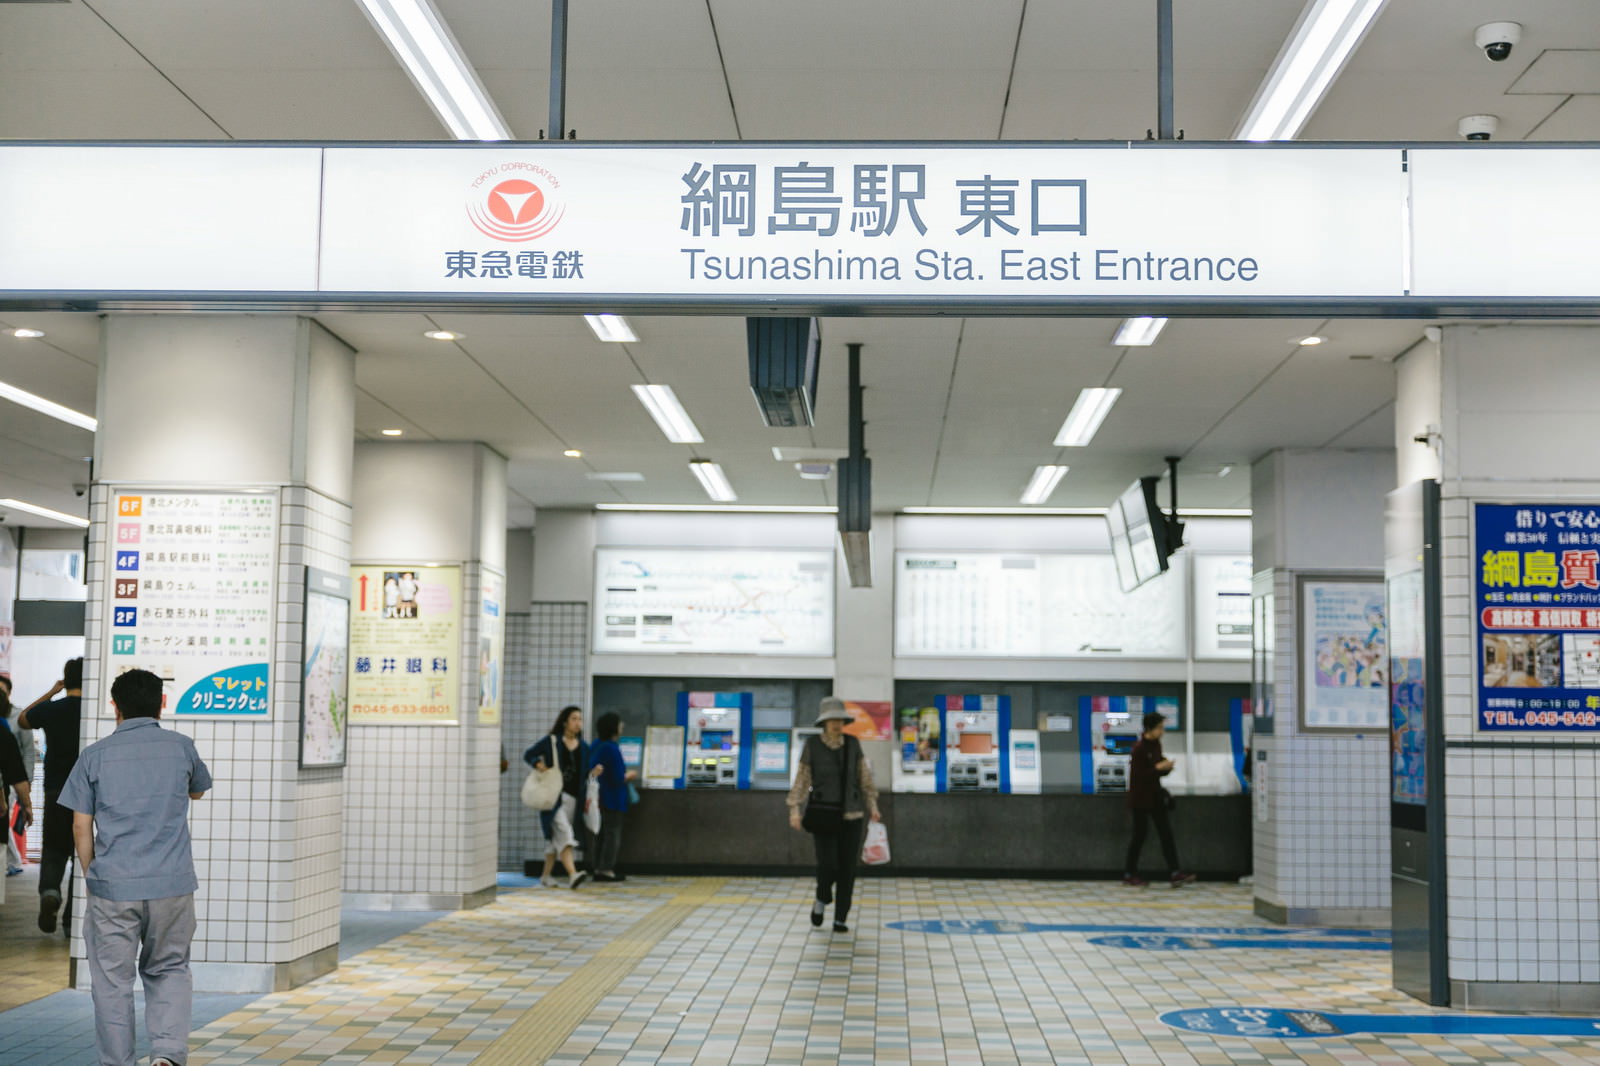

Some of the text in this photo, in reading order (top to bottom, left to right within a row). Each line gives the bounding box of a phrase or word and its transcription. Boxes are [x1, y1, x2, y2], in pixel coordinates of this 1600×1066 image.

[471, 161, 561, 189] TOKYU CORPORATION
[680, 162, 1088, 239] 綱島駅 東口
[444, 250, 584, 278] 東急電鉄
[680, 249, 1259, 281] Tsunashima Sta. East Entrance
[121, 500, 139, 513] 6F
[119, 527, 138, 540] 5F
[118, 556, 138, 568] 4F
[1482, 549, 1600, 590] 綱島質
[117, 583, 137, 595] 3F
[116, 611, 135, 624] 2F
[116, 639, 134, 652] 1F
[354, 656, 448, 674] 藤井眼科
[212, 676, 267, 692] マレット
[192, 690, 268, 712] クリニックビル
